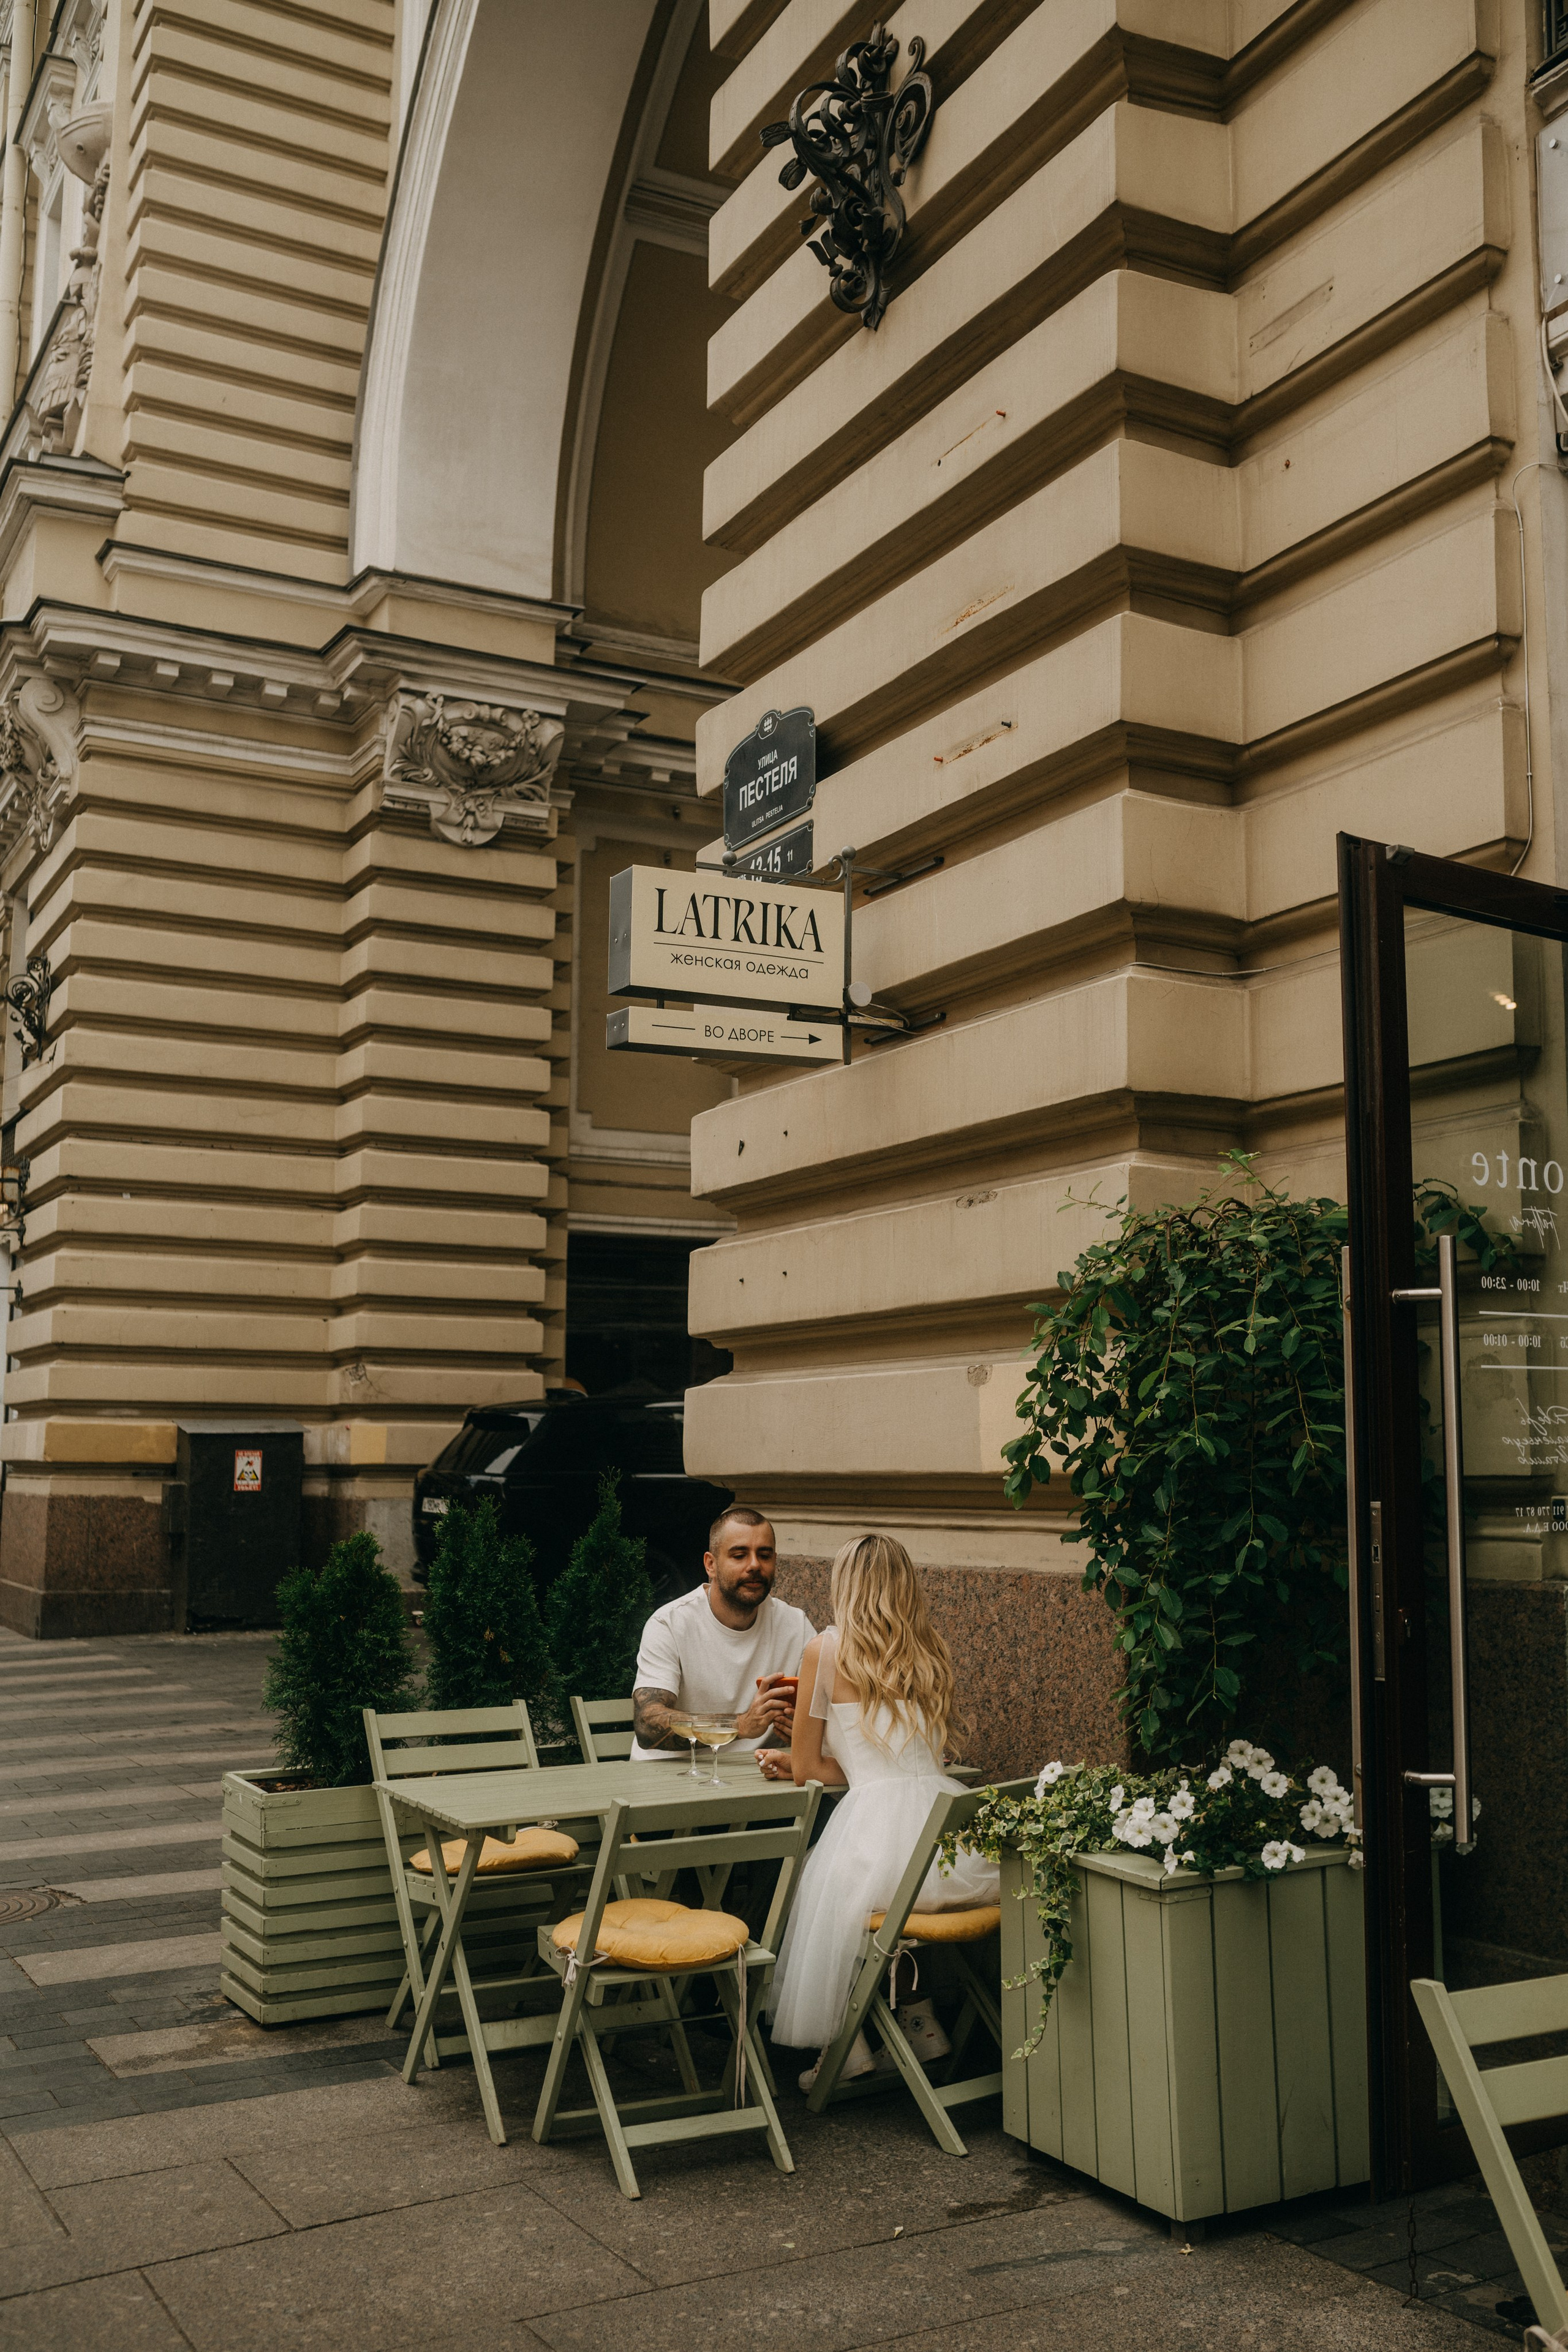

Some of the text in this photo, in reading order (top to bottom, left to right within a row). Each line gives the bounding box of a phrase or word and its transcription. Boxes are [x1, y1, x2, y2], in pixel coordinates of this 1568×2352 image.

[758, 748, 778, 770] УЛИЦА
[739, 755, 797, 812] ПЕСТЕЛЯ
[751, 804, 783, 828] ULITSA PESTELIA
[787, 849, 793, 862] 11
[654, 888, 824, 953] LATRIKA
[670, 952, 809, 979] женская одежда
[705, 1025, 775, 1043] ВО ДВОРЕ
